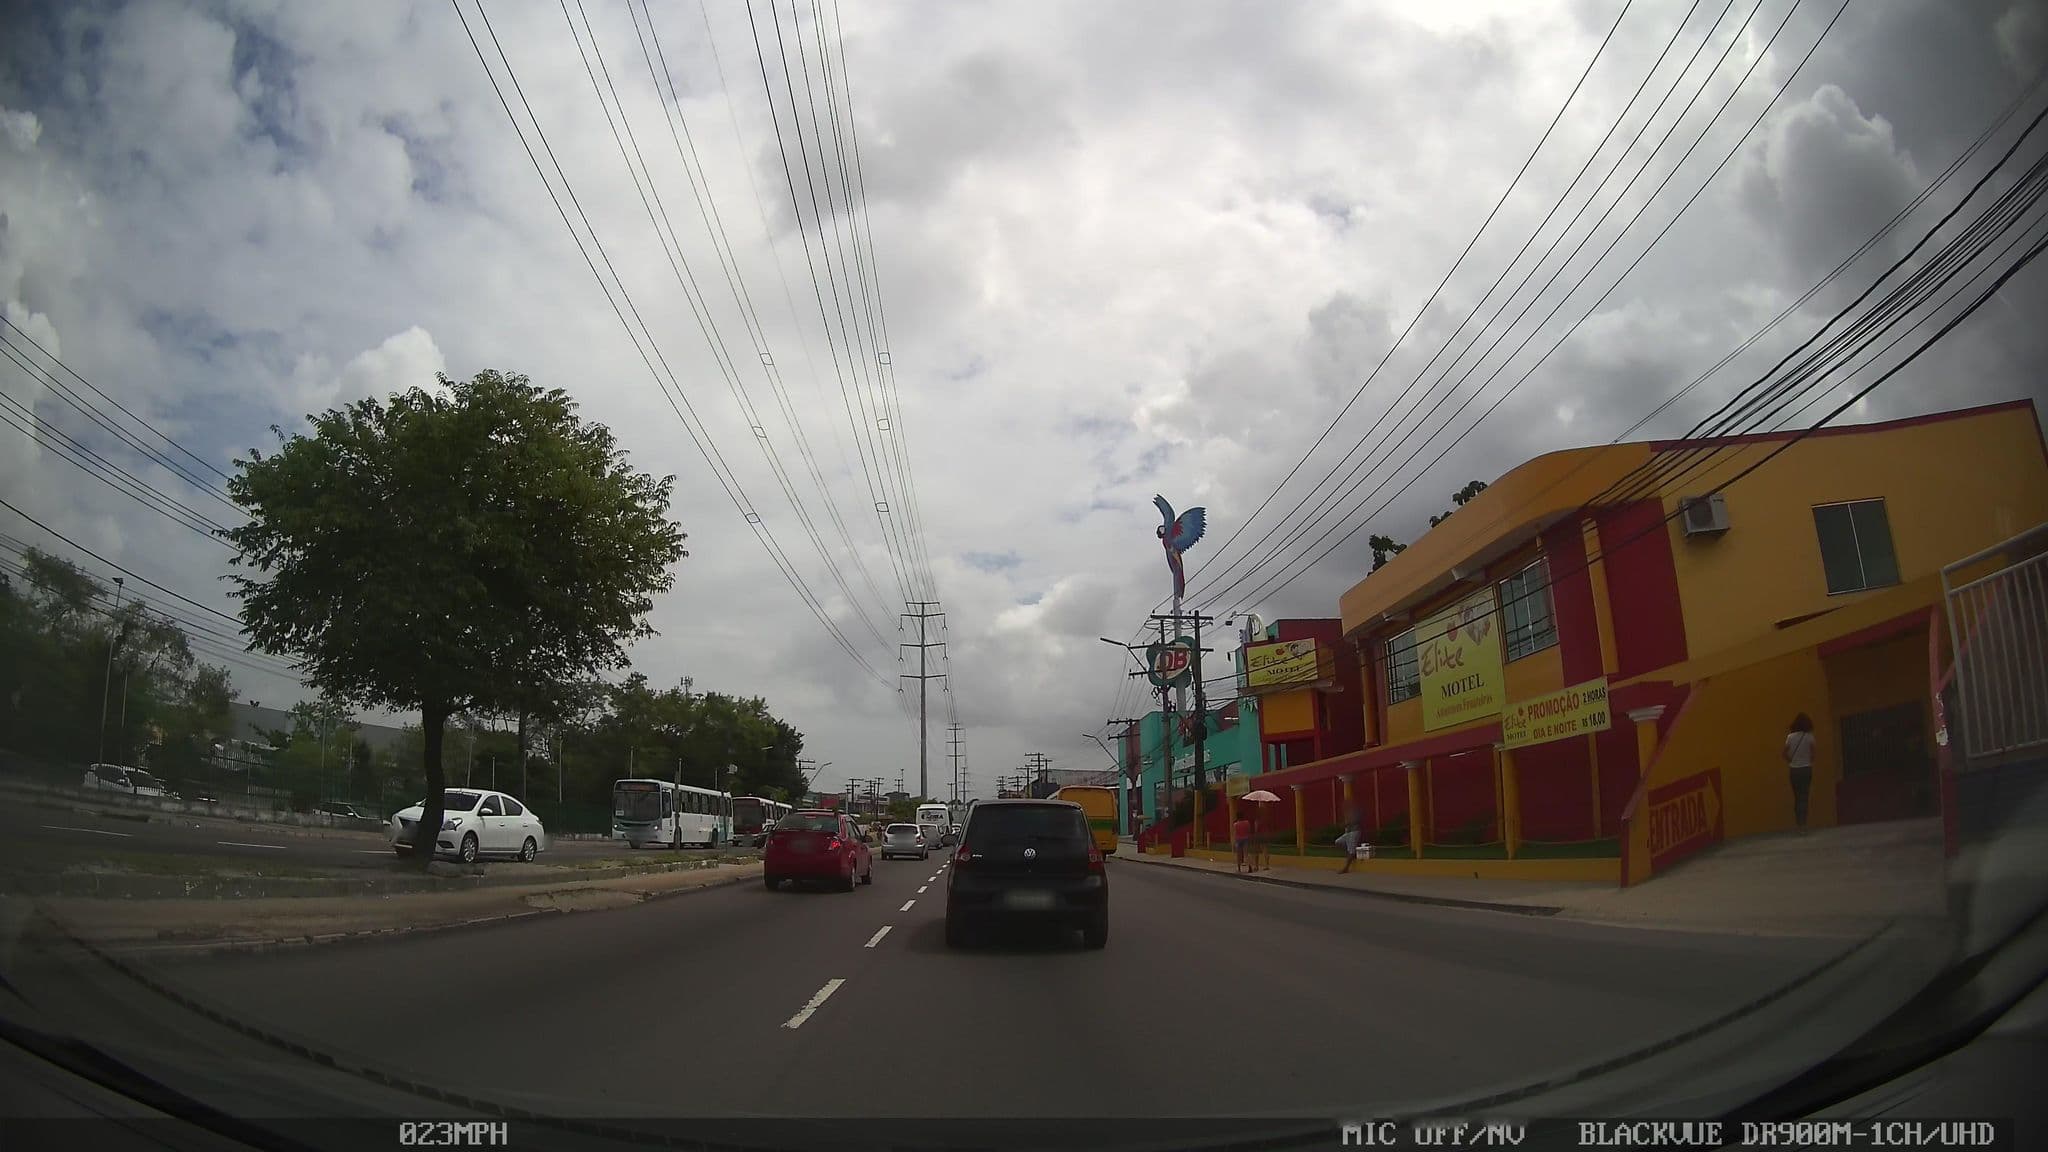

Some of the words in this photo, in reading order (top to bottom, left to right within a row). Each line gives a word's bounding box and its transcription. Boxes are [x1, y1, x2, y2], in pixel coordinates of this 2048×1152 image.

[1421, 640, 1465, 678] Elite
[1440, 673, 1485, 700] MOTEL
[1587, 687, 1606, 703] HORAS
[1527, 690, 1580, 721] PROMOÇÃO
[1533, 727, 1546, 740] DIA
[1547, 724, 1553, 737] E
[1553, 719, 1578, 735] NOITE
[1649, 791, 1708, 856] ENTRADA
